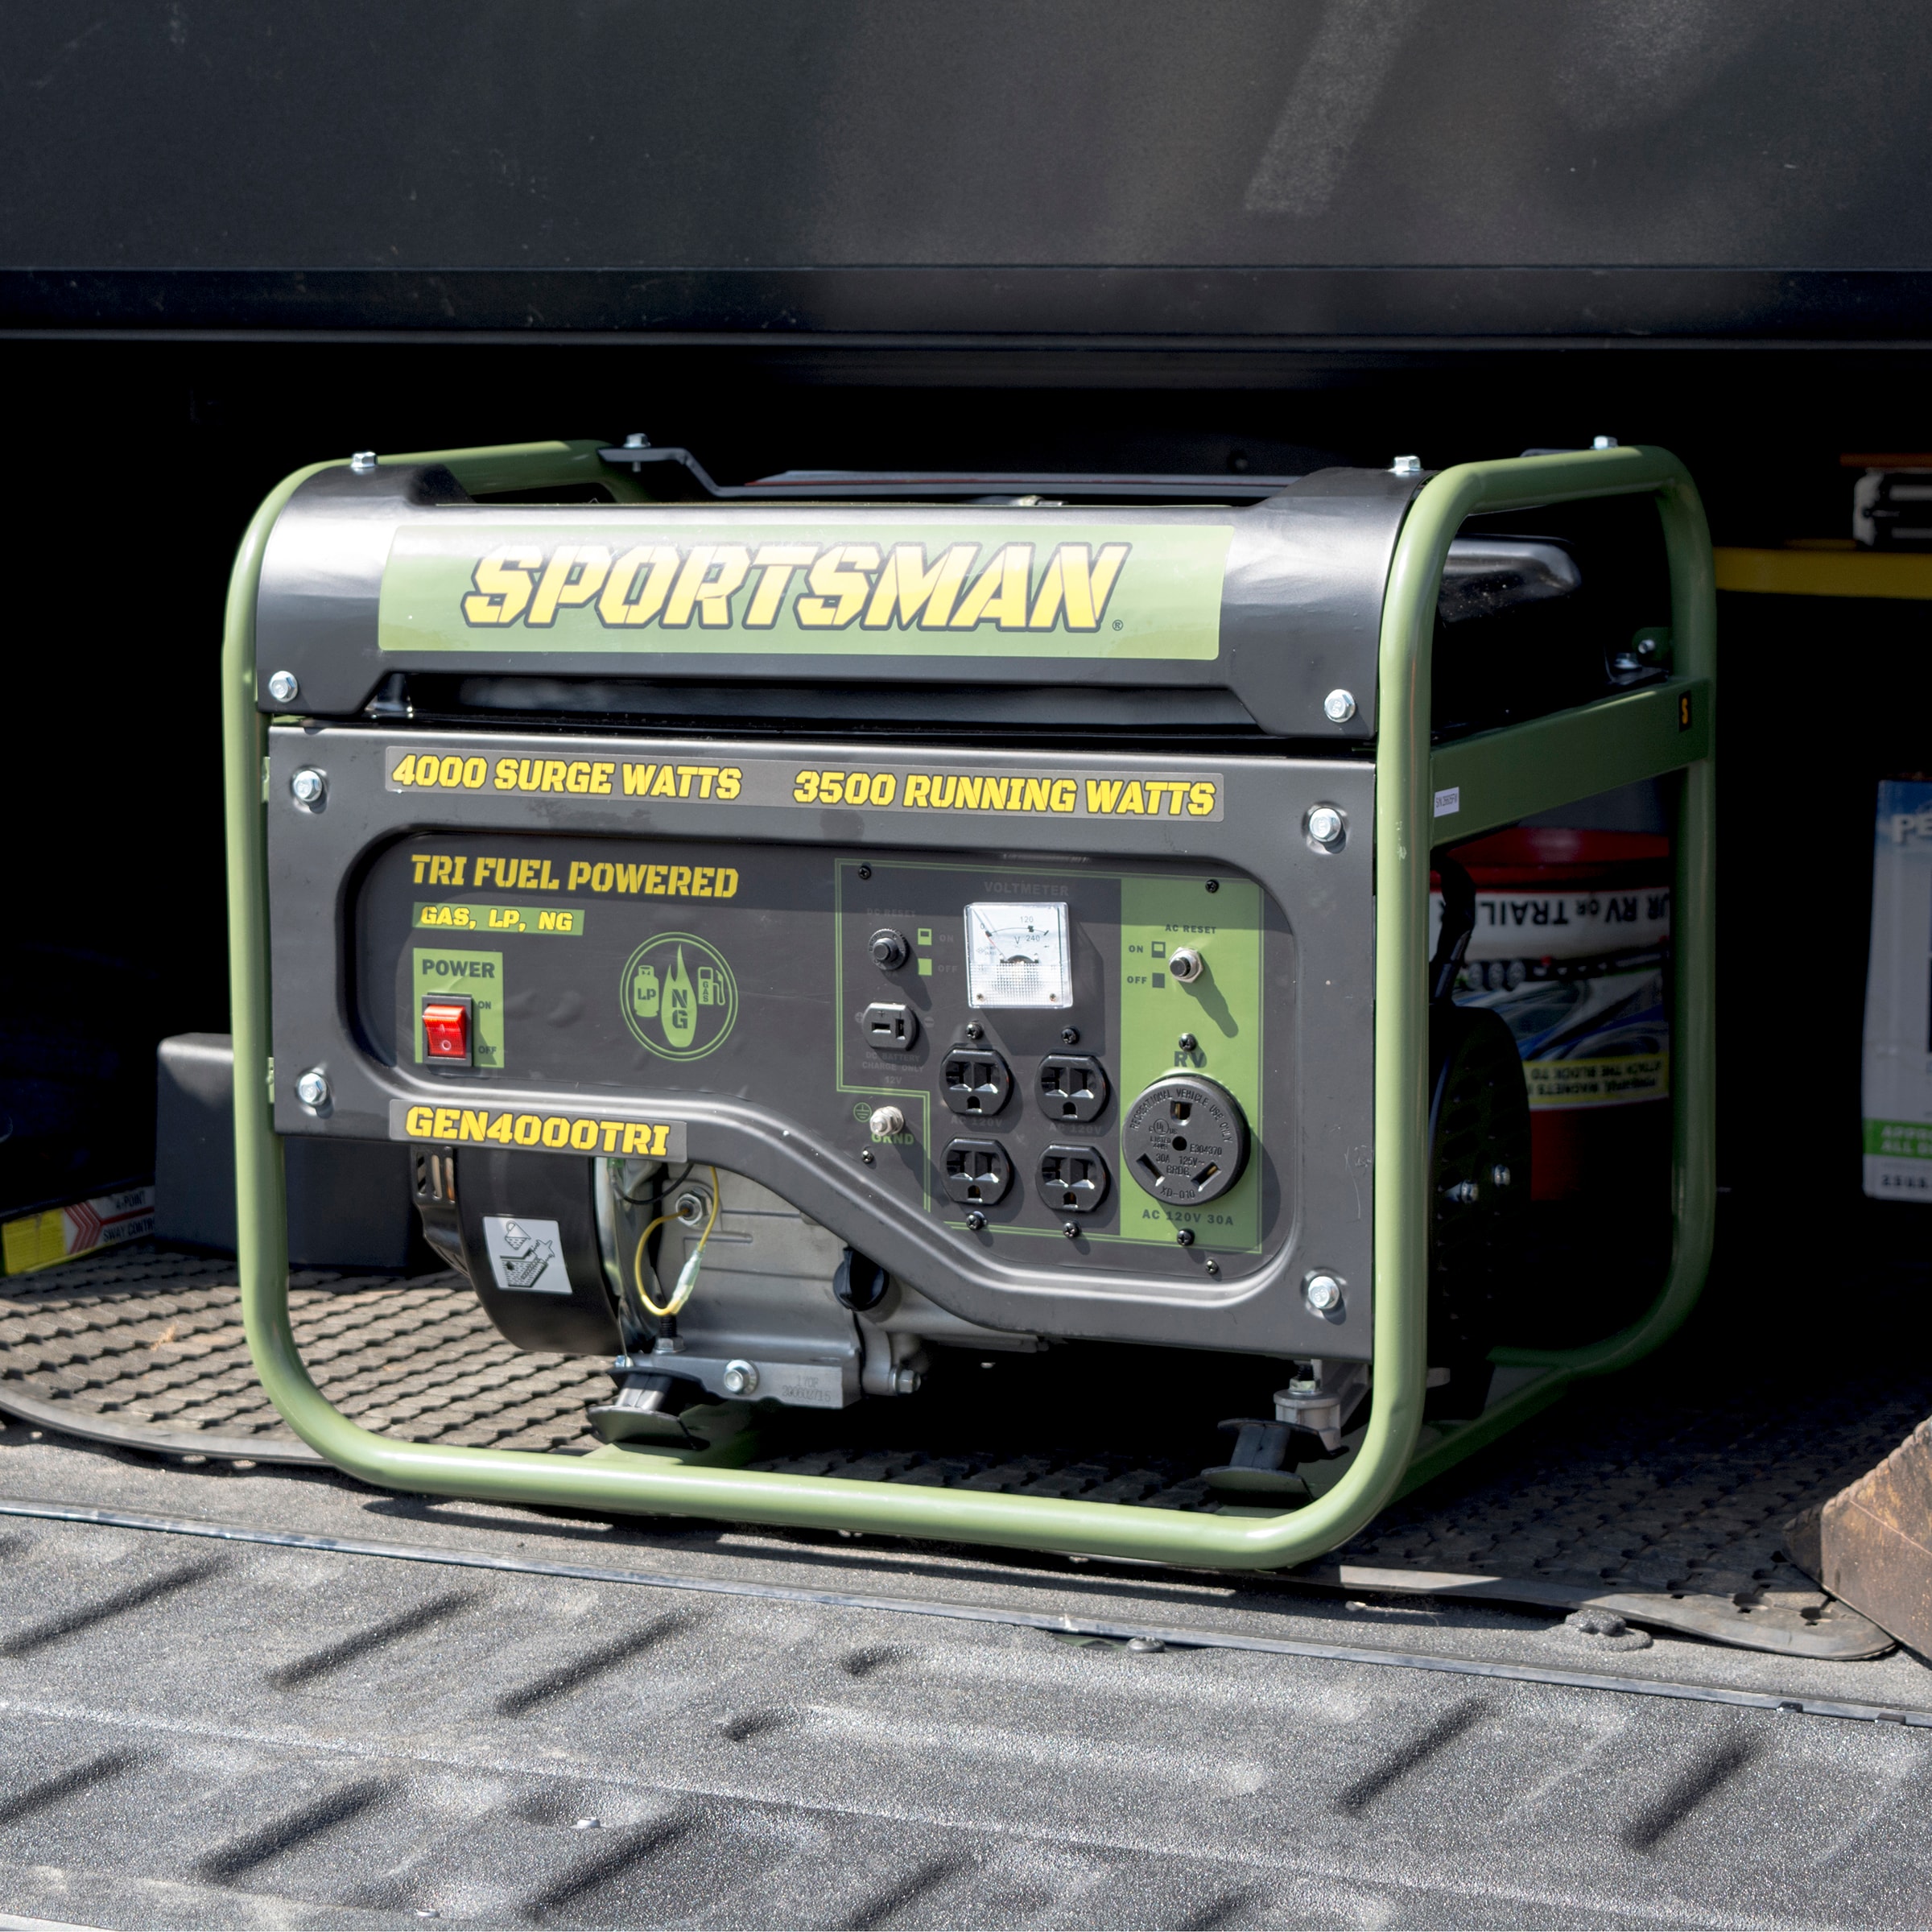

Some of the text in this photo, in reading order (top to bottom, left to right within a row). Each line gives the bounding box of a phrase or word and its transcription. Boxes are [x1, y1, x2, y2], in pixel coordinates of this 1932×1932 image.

[461, 541, 1133, 633] SPORTSMAN
[391, 753, 1216, 816] 4000 SURGE WATTS 3500 RUNNING WATTS
[411, 854, 739, 898] TRI FUEL POWERED
[984, 881, 1069, 897] VOLTMETER
[1606, 896, 1637, 923] RV
[421, 906, 573, 932] GAS, LP, NG
[1020, 915, 1034, 923] 120
[1165, 924, 1216, 934] AC RESET
[939, 935, 954, 943] ON
[1129, 945, 1144, 953] ON
[422, 959, 495, 978] POWER
[938, 965, 958, 973] OFF
[1126, 976, 1147, 985] OFF
[638, 988, 656, 1001] LP
[477, 1001, 491, 1009] ON
[478, 1046, 497, 1055] OFF
[865, 1051, 920, 1061] DC BATTERY
[1174, 1051, 1205, 1068] RV
[862, 1061, 897, 1071] CHARGE
[885, 1075, 902, 1084] 12V
[1129, 1088, 1233, 1142] RECREATIONAL VEHICLE USE ONLY
[950, 1117, 1002, 1127] AC 120V
[405, 1105, 671, 1157] GEN4000TRI
[1070, 1125, 1102, 1134] 120V
[871, 1133, 914, 1145] GRND
[1190, 1144, 1223, 1155] E304370
[1155, 1153, 1170, 1162] 30A
[1160, 1186, 1195, 1199] XD-010
[1141, 1209, 1234, 1225] AC 120V 30A
[103, 1225, 125, 1243] SWAY
